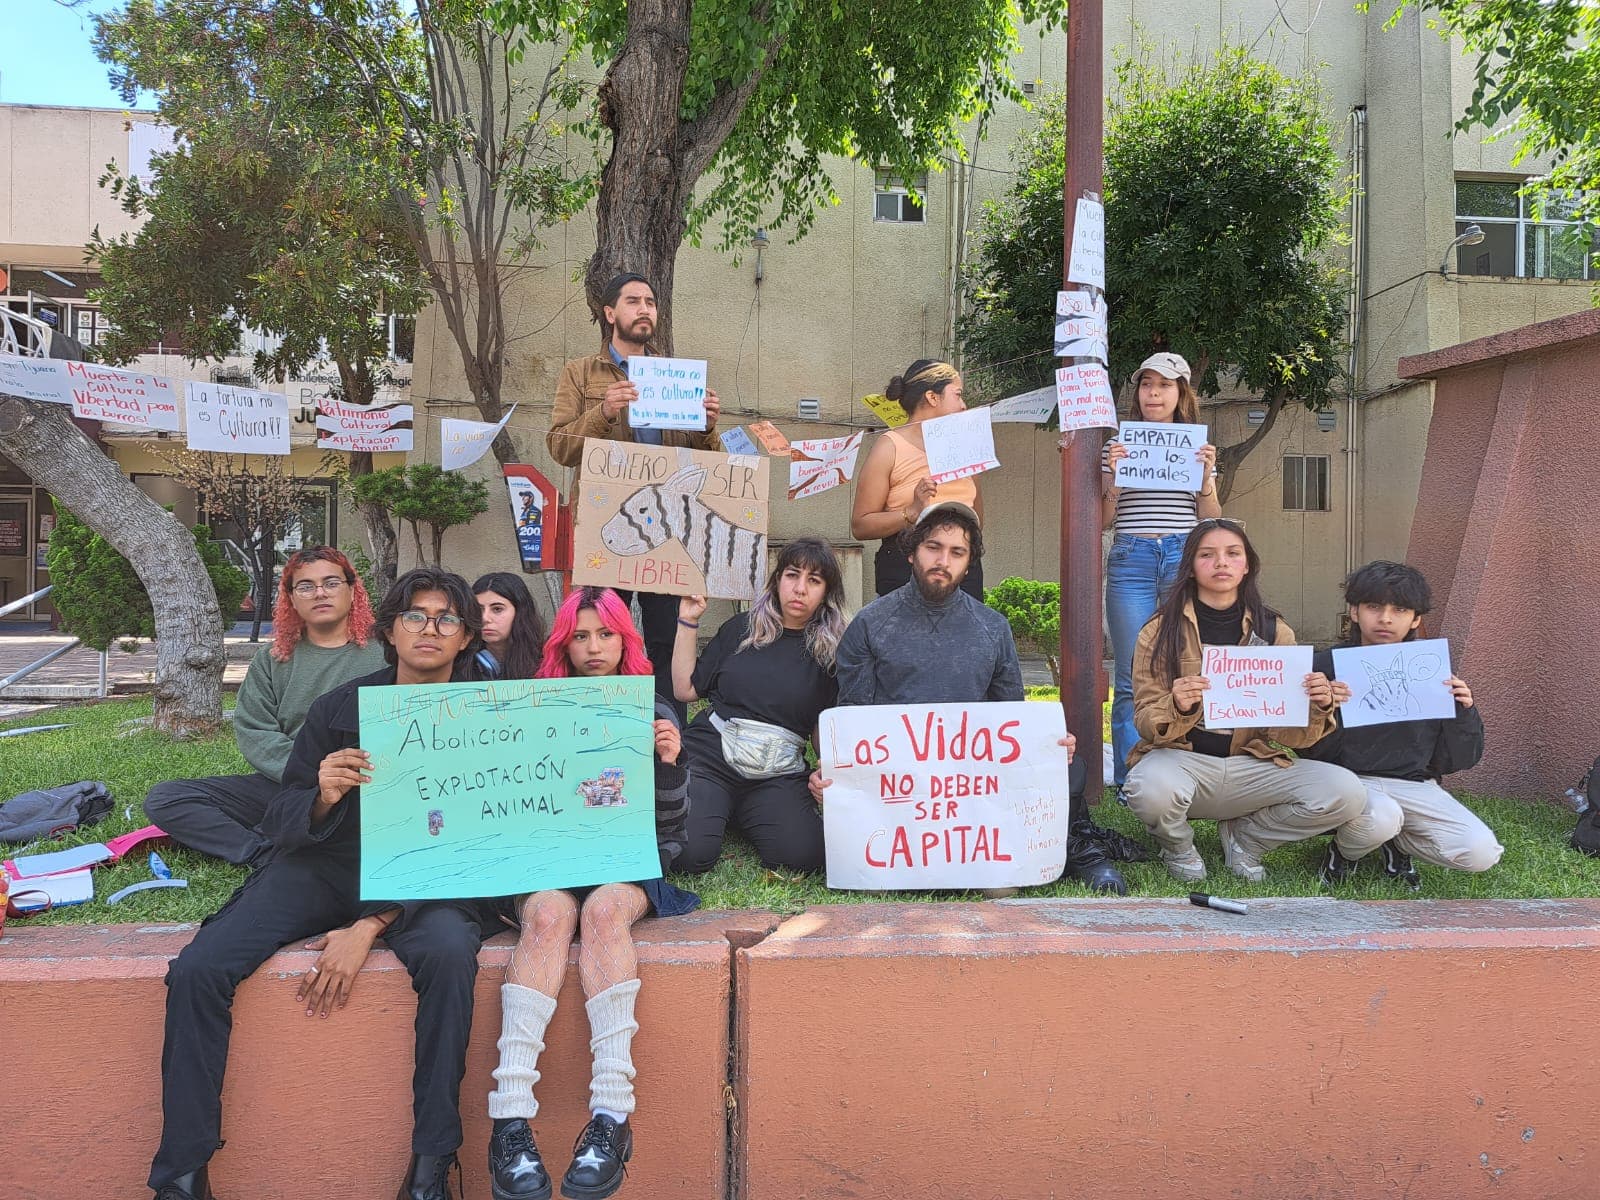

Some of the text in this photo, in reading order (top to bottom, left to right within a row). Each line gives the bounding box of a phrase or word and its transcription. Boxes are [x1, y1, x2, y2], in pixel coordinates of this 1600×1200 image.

[1063, 321, 1080, 336] UN
[67, 362, 168, 389] Muerte a la
[633, 361, 645, 377] La
[651, 361, 686, 379] tortura
[1059, 369, 1074, 382] Un
[189, 382, 274, 408] La tortura no
[643, 386, 656, 400] es
[1060, 384, 1081, 397] para
[147, 402, 175, 414] para
[1060, 398, 1073, 407] un
[1077, 393, 1092, 405] mal
[198, 410, 211, 421] es
[317, 399, 389, 420] Patrimonio
[1064, 409, 1086, 422] para
[340, 418, 392, 430] Cultural
[802, 441, 816, 451] No
[832, 439, 844, 450] los
[1124, 429, 1192, 447] EMPATIA
[1128, 448, 1186, 465] on los
[587, 446, 758, 501] QUIERO SER
[1119, 464, 1190, 483] animales
[618, 558, 690, 586] LIBRE
[1226, 672, 1284, 690] Cultural
[1209, 700, 1286, 720] Esclavitud
[398, 718, 590, 757] Abolición a la
[829, 710, 1021, 769] Las Vidas
[416, 753, 567, 801] EXPLOTACIÓN
[880, 773, 1000, 799] NO DEBEN
[481, 793, 564, 820] ANIMAL
[915, 801, 959, 820] SER
[865, 825, 1012, 869] CAPITAL
